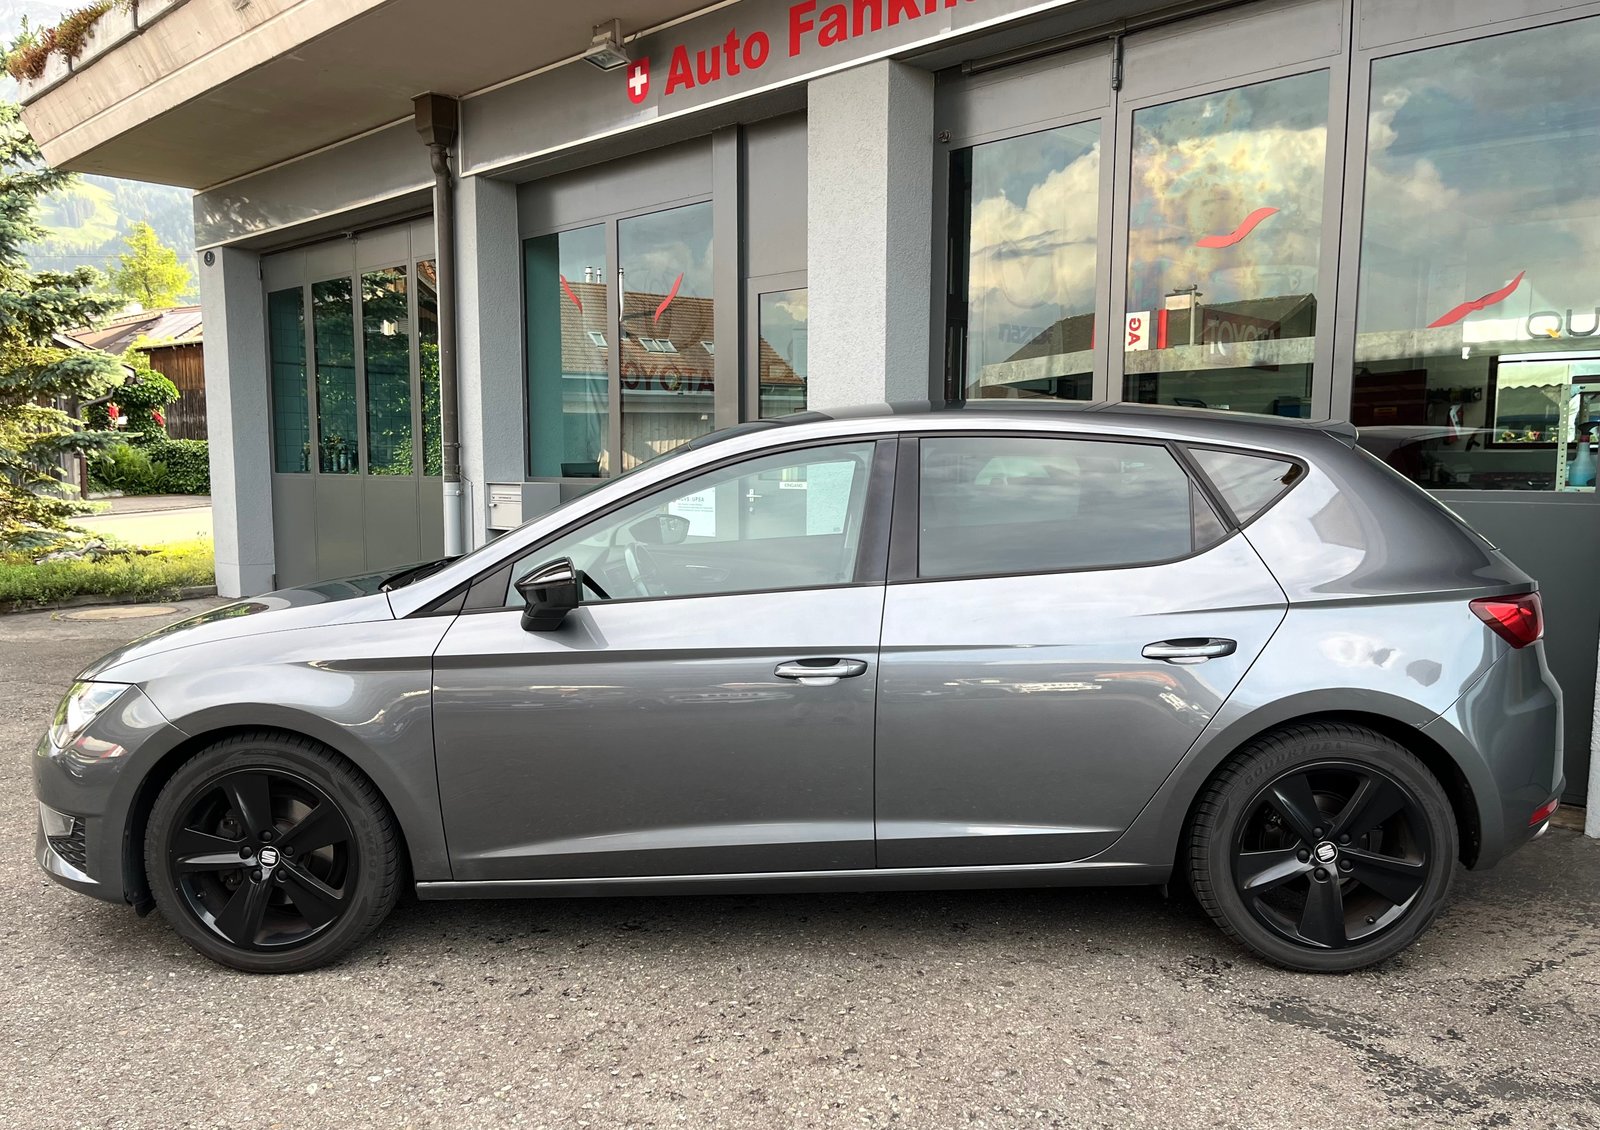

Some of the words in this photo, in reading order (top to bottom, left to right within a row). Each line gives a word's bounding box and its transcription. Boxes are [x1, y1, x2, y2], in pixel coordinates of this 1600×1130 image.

[664, 27, 770, 96] Auto
[1207, 318, 1278, 362] TOYOTA
[619, 361, 715, 392] OYOTA
